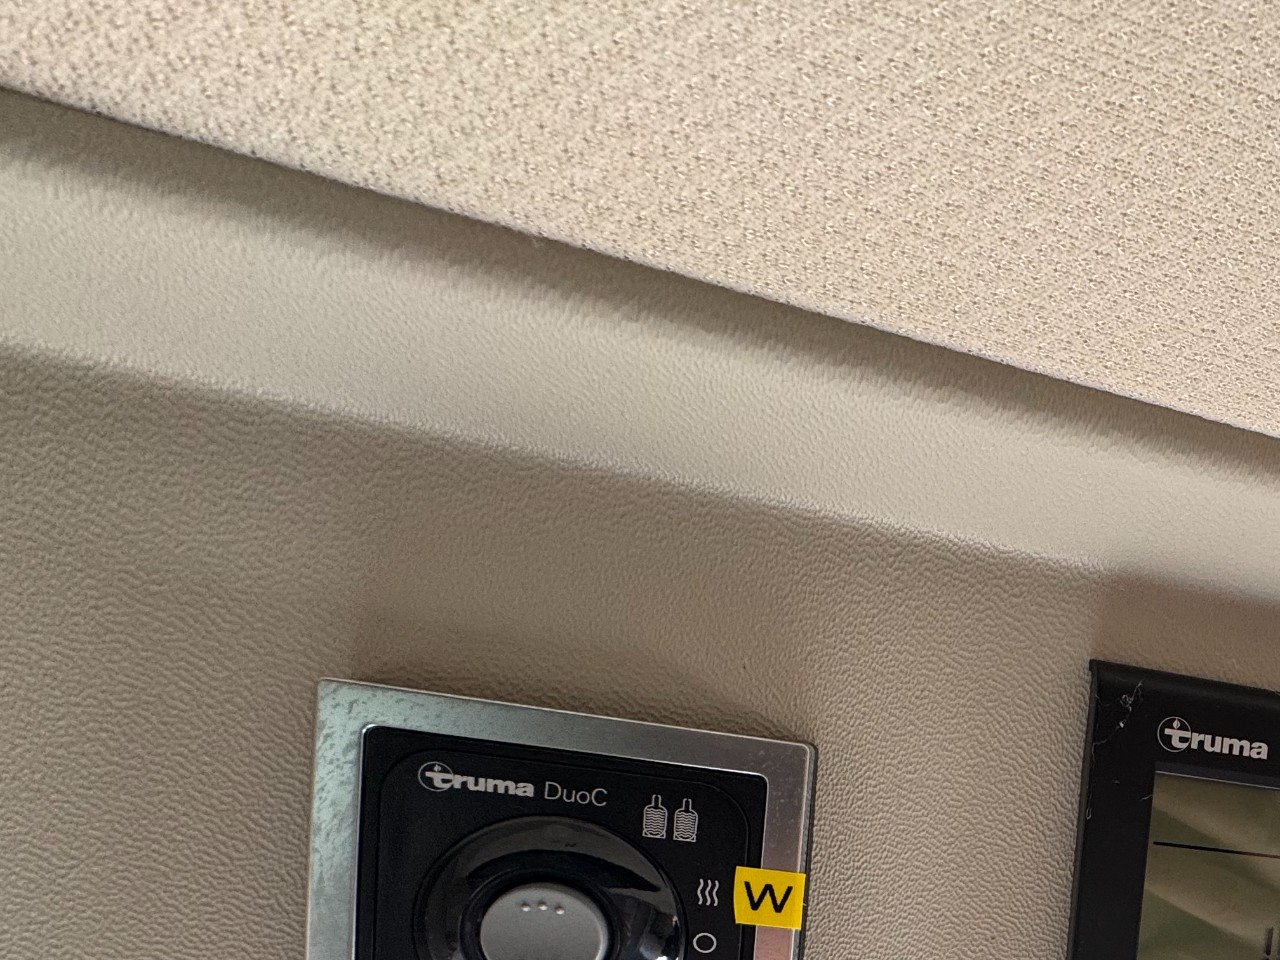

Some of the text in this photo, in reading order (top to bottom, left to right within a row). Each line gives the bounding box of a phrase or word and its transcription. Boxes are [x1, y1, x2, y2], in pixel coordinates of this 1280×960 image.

[1165, 722, 1269, 761] truma
[424, 764, 608, 808] truma DuoC
[743, 880, 794, 914] W
